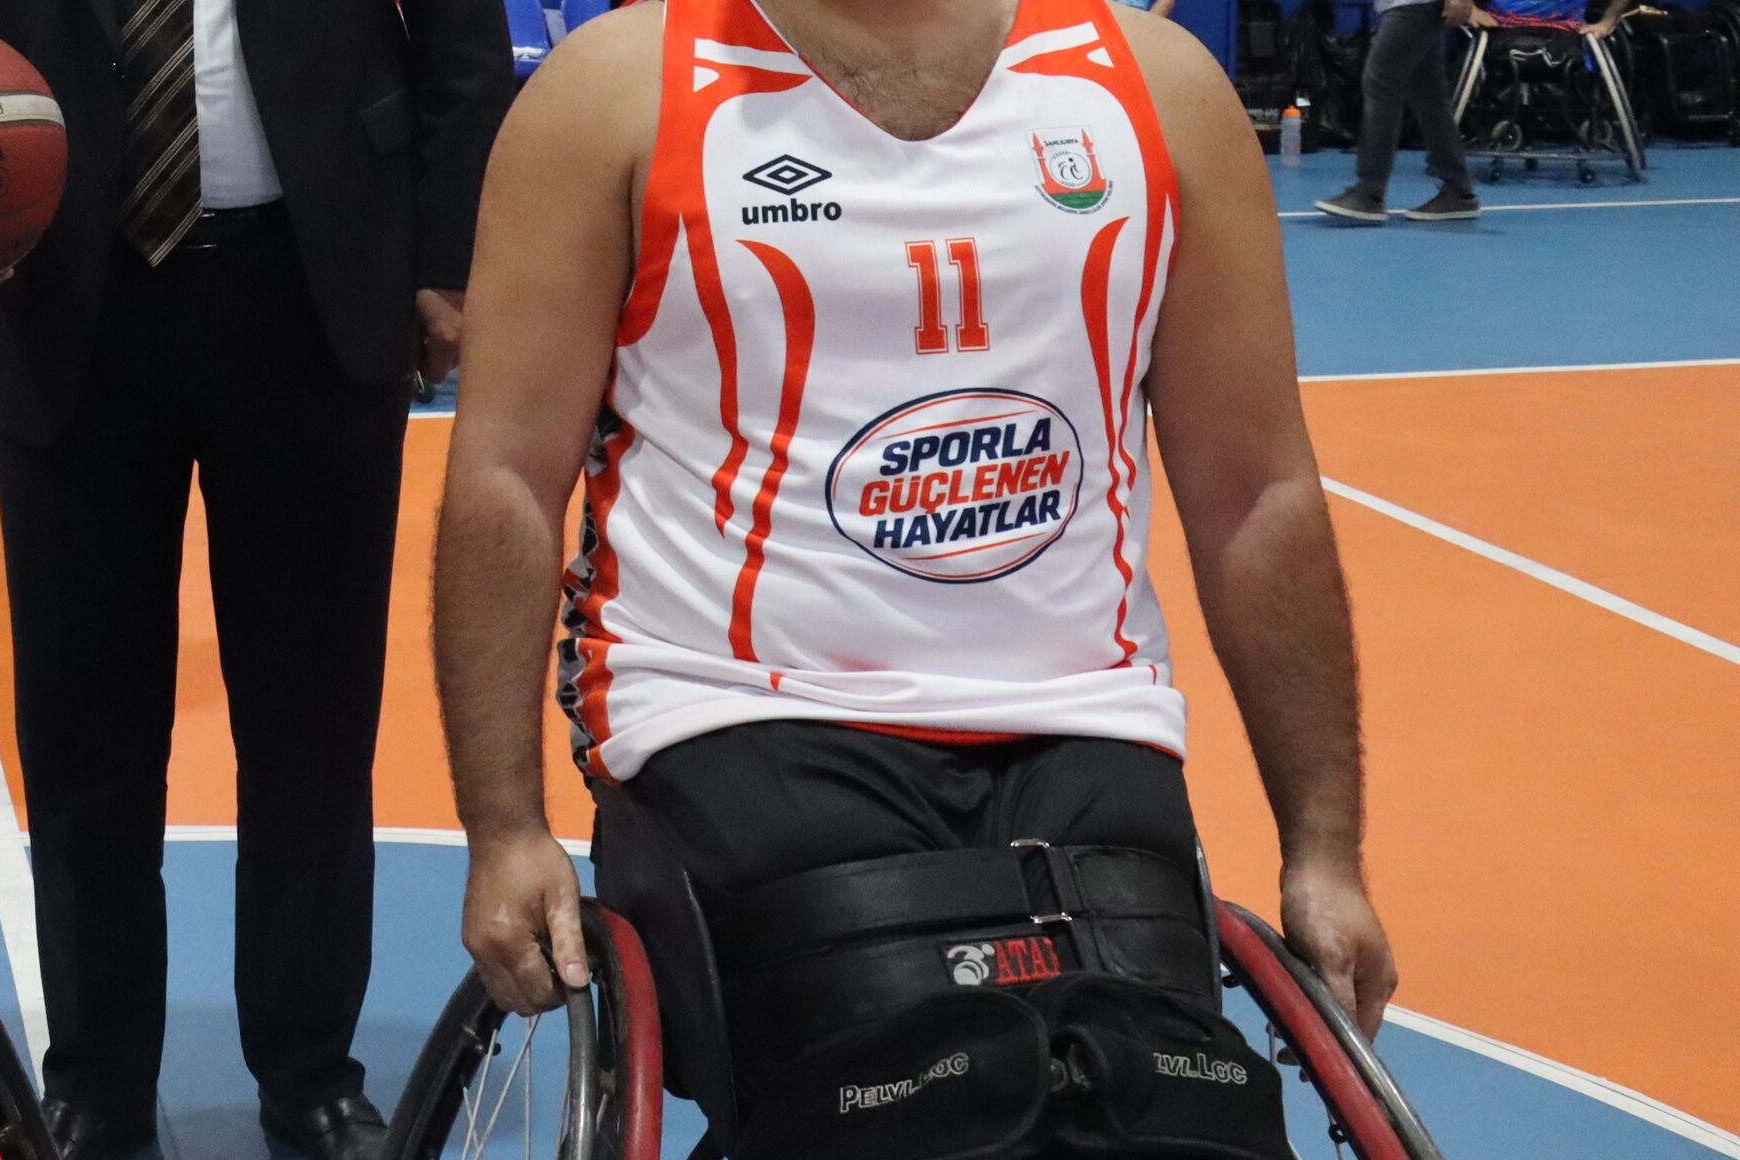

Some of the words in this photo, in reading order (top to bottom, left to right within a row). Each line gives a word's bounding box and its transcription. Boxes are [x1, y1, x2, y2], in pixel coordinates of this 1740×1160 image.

[741, 198, 842, 226] umbro
[904, 237, 990, 355] 11
[879, 417, 1051, 476] SPORLA
[858, 450, 1070, 517] GÜÇLENEN
[873, 490, 1061, 549] HAYATLAR
